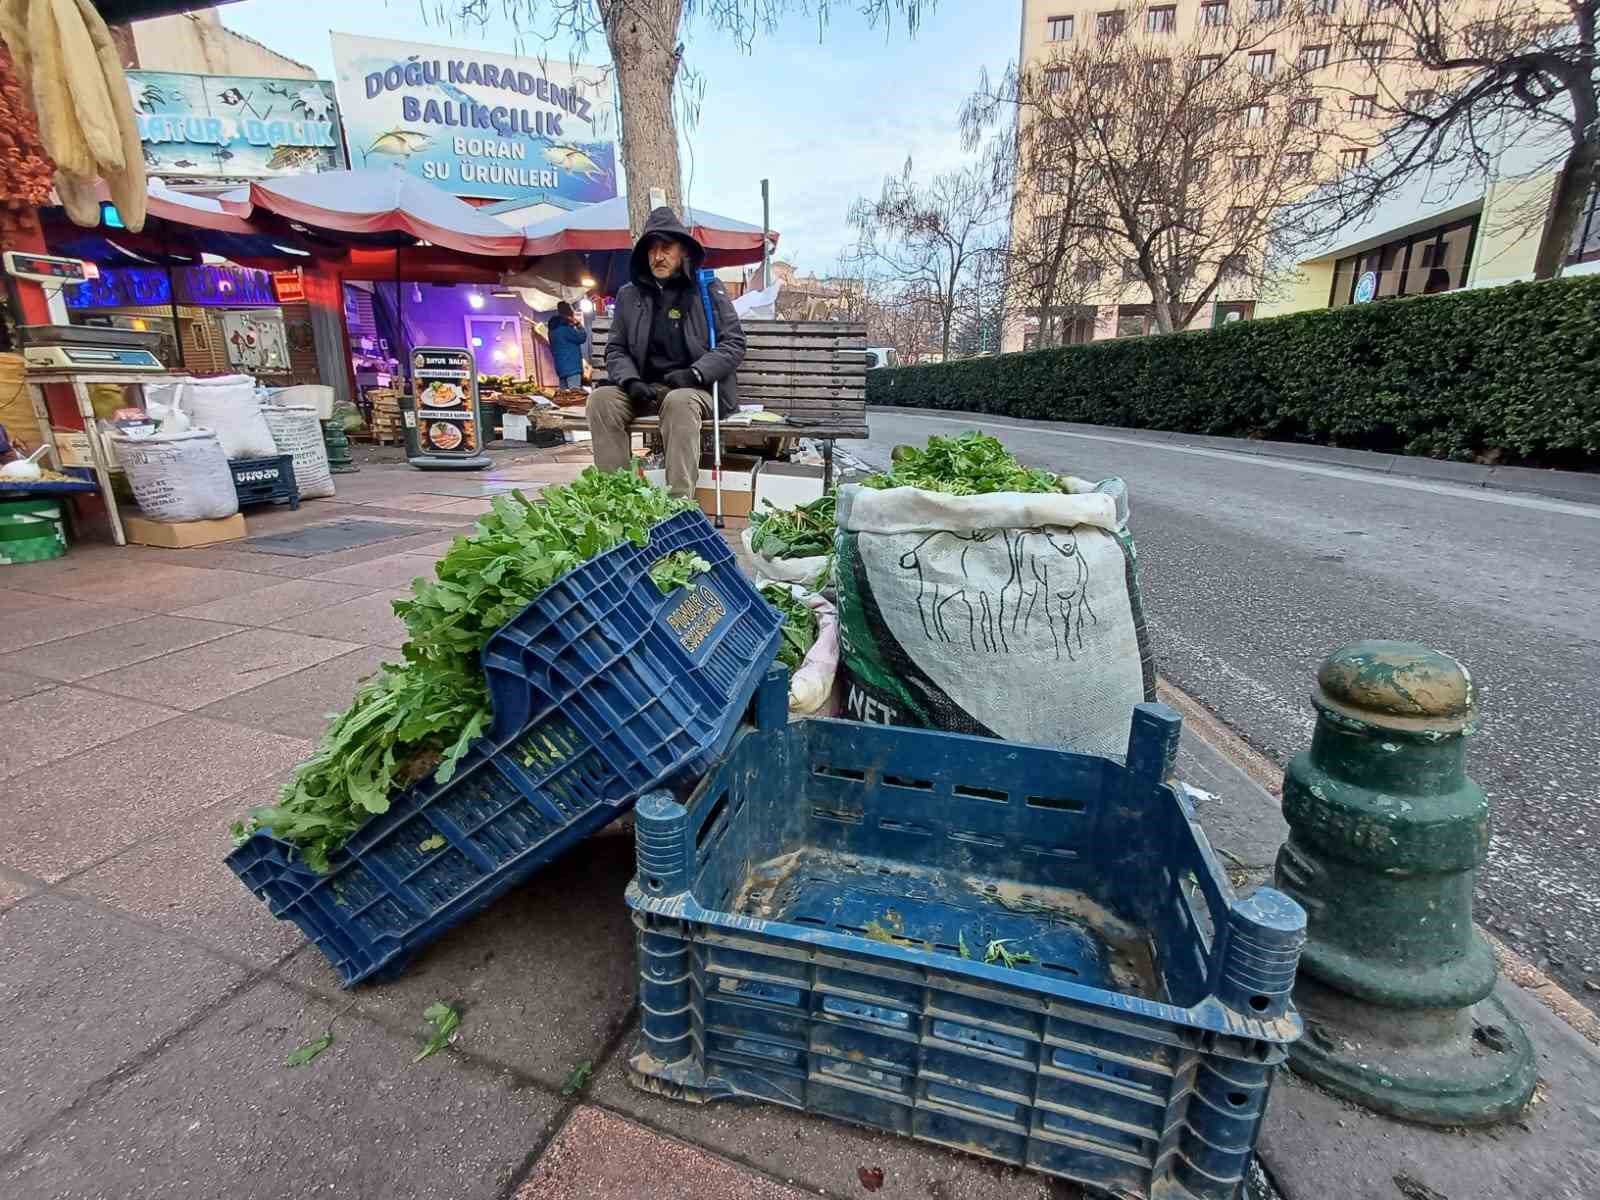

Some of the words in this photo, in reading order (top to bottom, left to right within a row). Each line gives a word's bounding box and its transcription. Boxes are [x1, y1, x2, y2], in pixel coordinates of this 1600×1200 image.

[365, 55, 441, 99] DOĞU
[448, 60, 593, 123] KARADENİZ
[402, 95, 564, 138] BALIKÇILIK
[453, 136, 525, 160] BORAN
[423, 160, 450, 181] SU
[461, 160, 559, 189] ÜRÜNLERİ
[848, 684, 897, 726] NET
